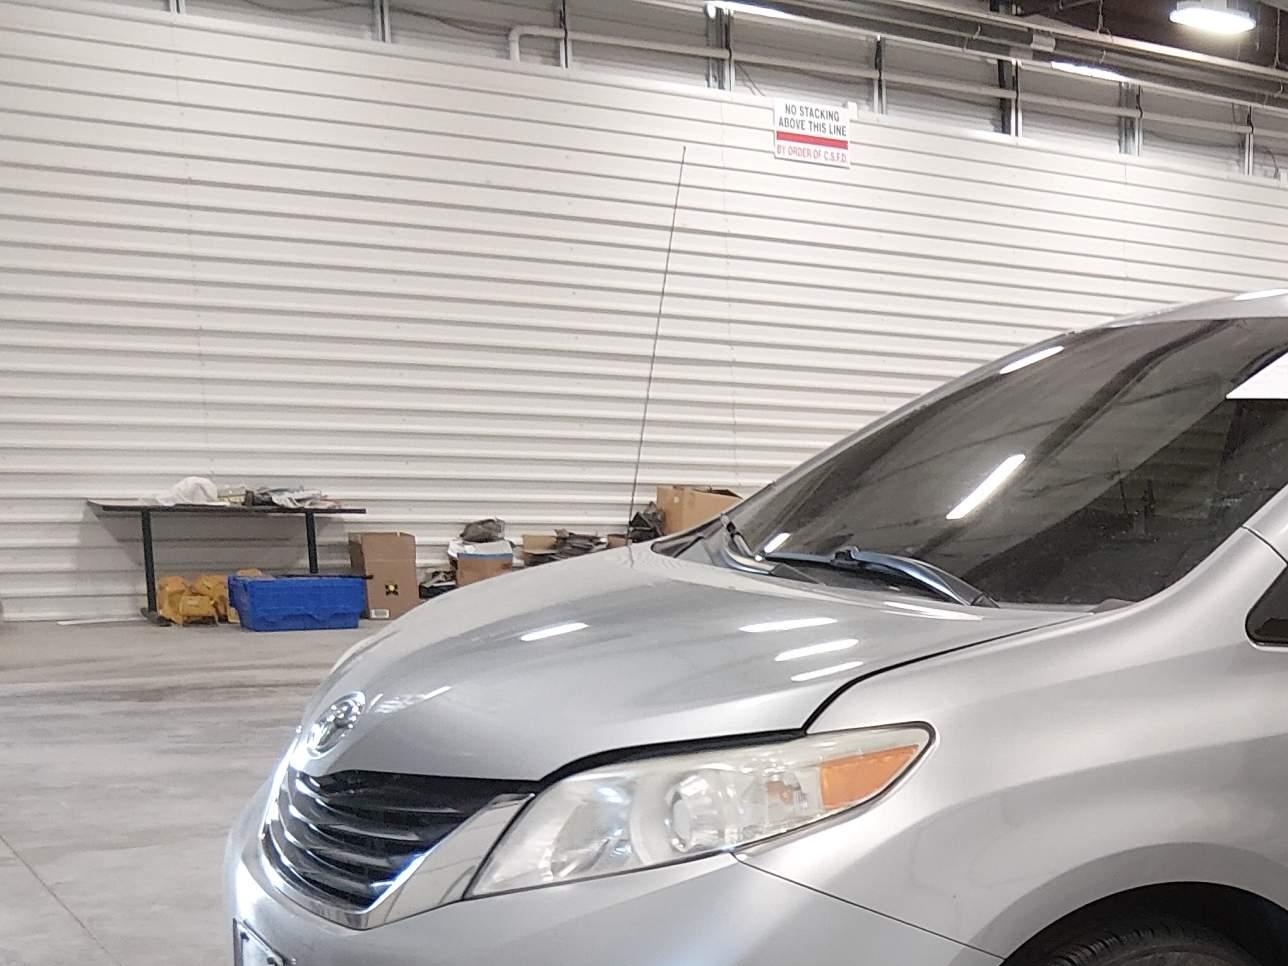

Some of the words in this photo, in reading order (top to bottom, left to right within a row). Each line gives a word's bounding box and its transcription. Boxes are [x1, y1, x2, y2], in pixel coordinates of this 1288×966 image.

[785, 104, 797, 116] NO
[799, 105, 840, 122] STACKING
[778, 117, 806, 130] ABOVE
[808, 120, 827, 134] THIS
[829, 123, 847, 137] LINE
[776, 144, 786, 154] BY
[788, 145, 812, 159] ORDER
[813, 149, 822, 160] OF
